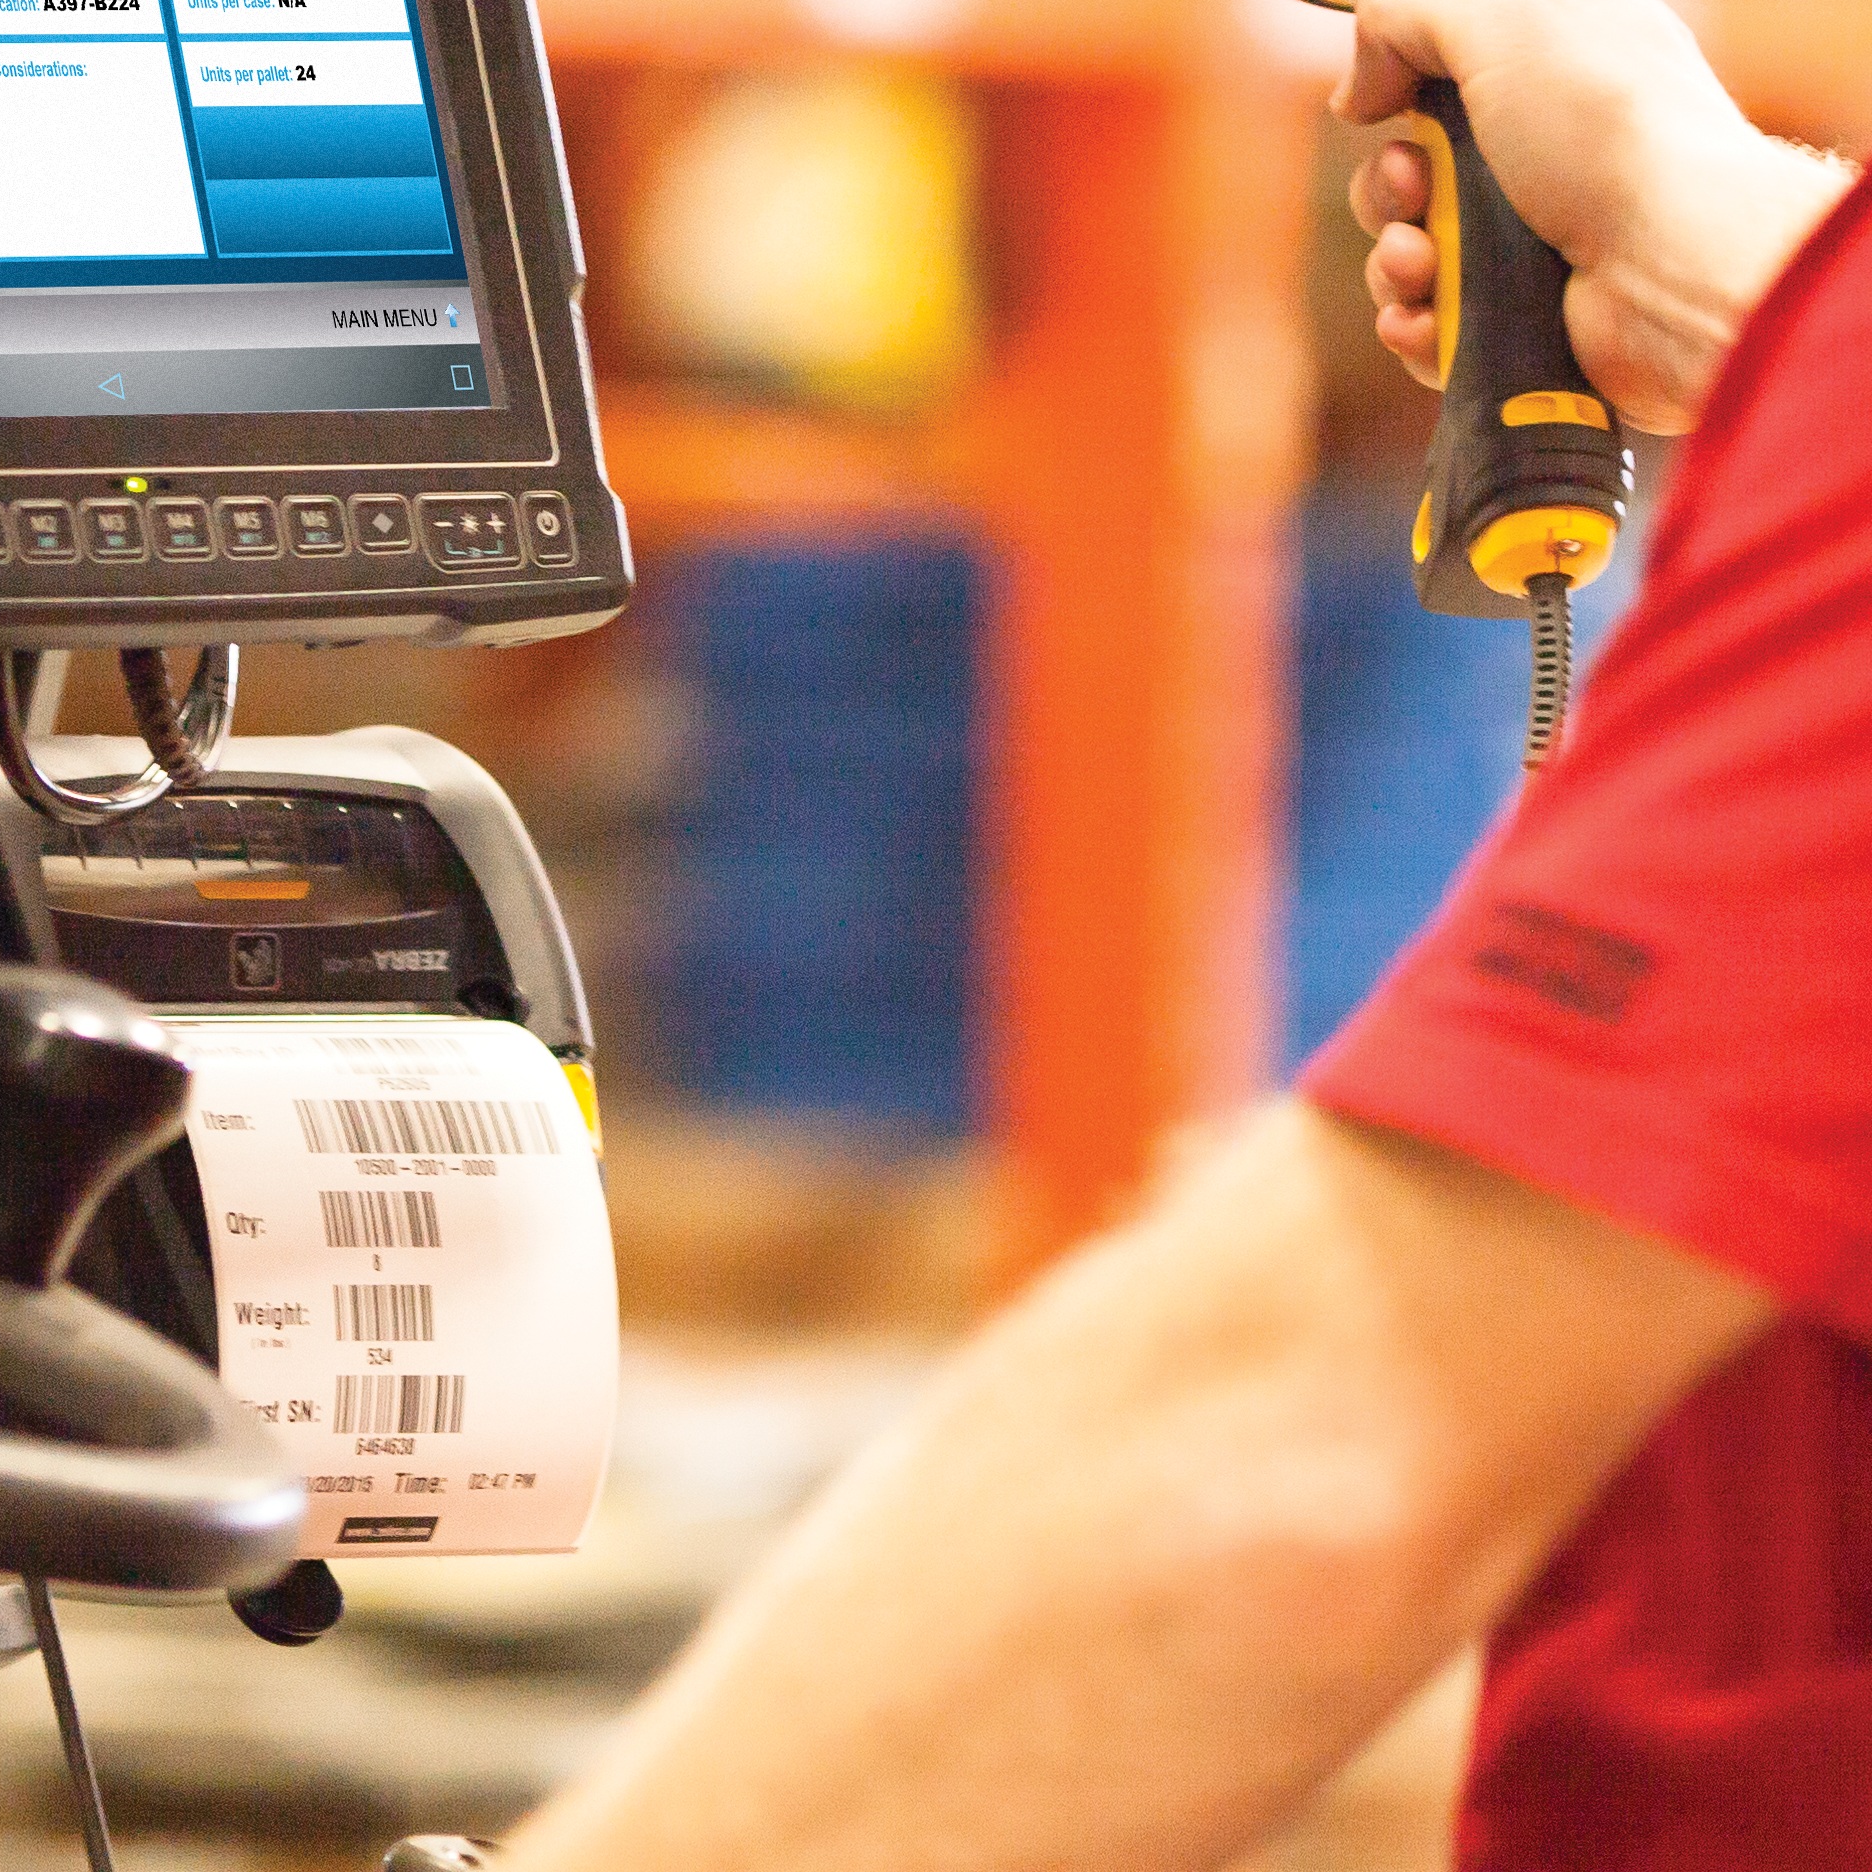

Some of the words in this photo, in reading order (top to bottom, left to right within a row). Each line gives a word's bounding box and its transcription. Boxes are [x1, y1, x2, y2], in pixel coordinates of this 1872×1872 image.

[200, 65, 232, 82] Units
[234, 68, 254, 86] per
[257, 65, 293, 85] pallet:
[295, 65, 316, 81] 24
[332, 310, 379, 329] MAIN
[383, 308, 438, 328] MENU
[372, 949, 449, 971] ZEBRA
[200, 1110, 256, 1132] Item:
[225, 1211, 266, 1239] Qty:
[233, 1301, 311, 1330] Weight:
[368, 1347, 393, 1365] 534
[286, 1399, 322, 1423] SN:
[393, 1473, 448, 1494] Time:
[512, 1473, 537, 1490] PM
